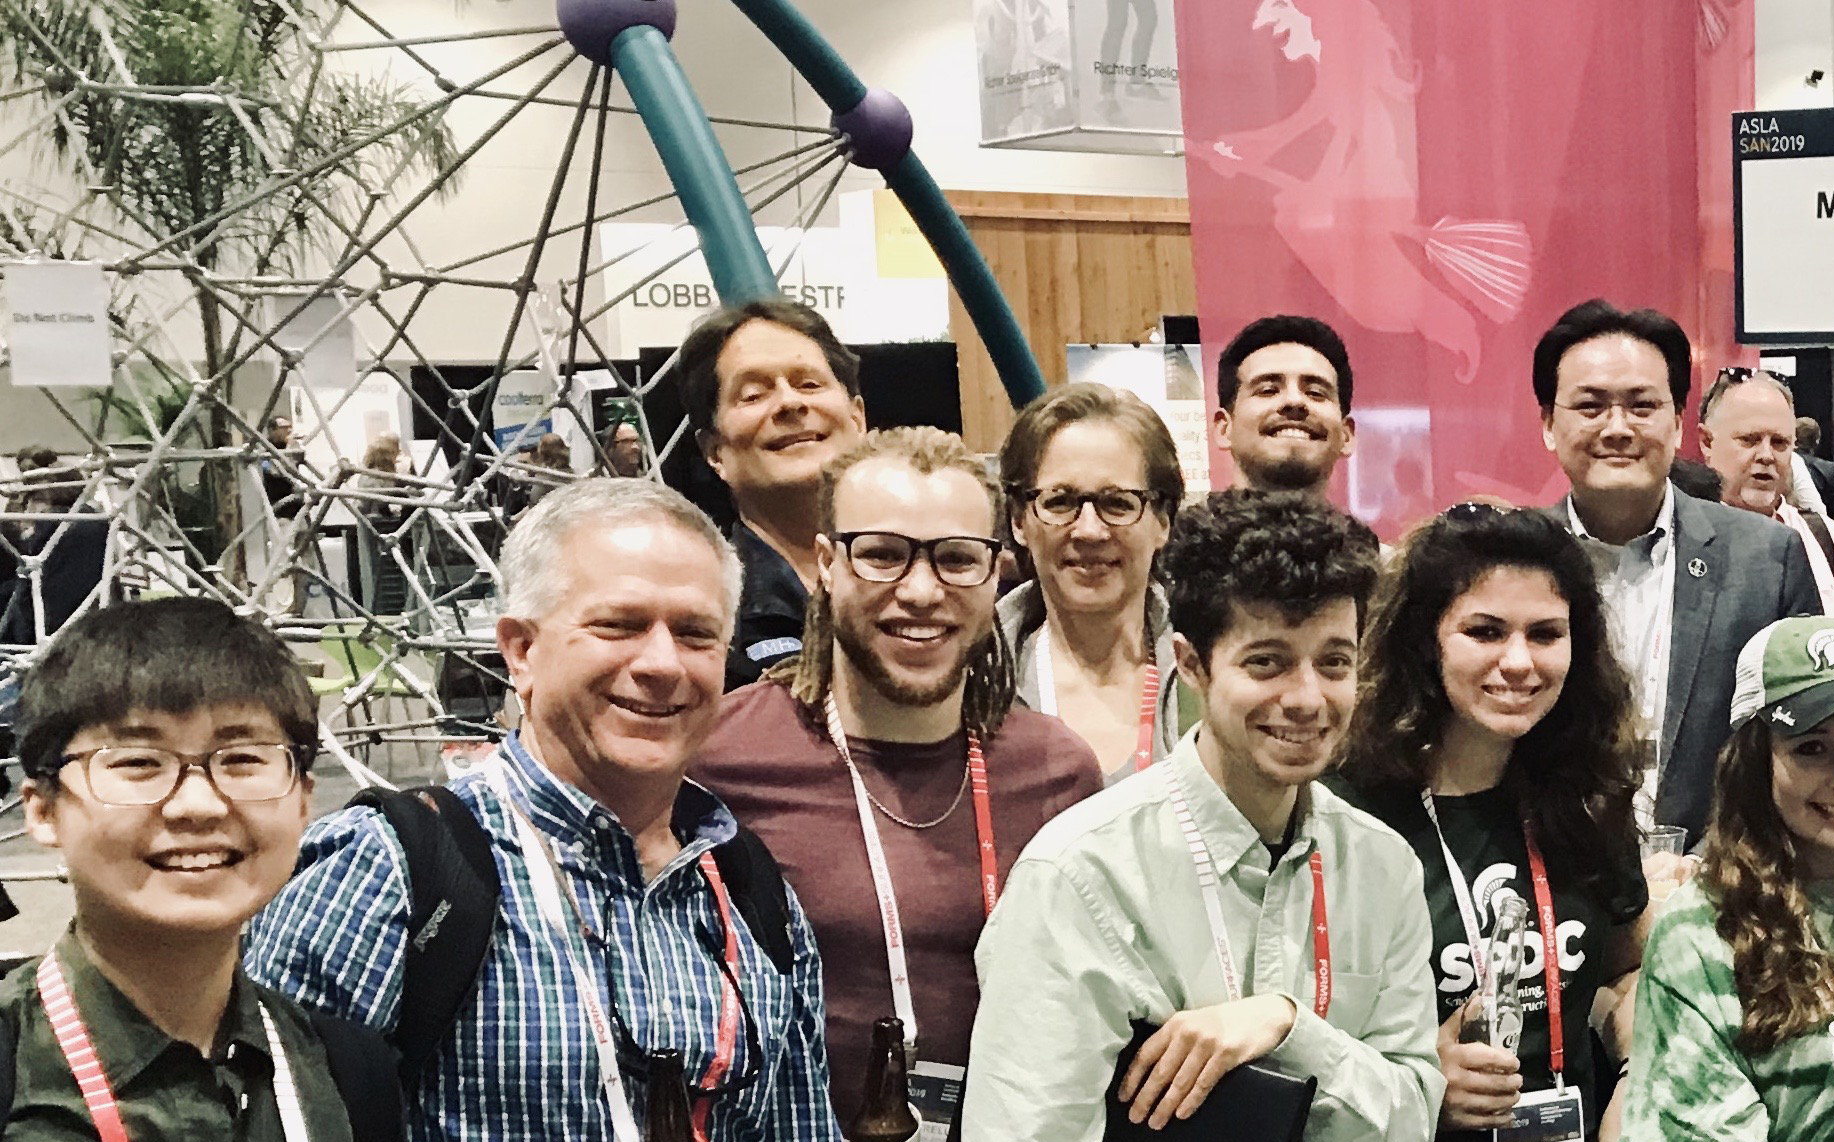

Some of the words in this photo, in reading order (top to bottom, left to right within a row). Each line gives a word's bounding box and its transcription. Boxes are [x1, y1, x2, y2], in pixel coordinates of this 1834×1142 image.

[1094, 61, 1137, 77] Richter
[1739, 117, 1779, 135] ASLA
[1740, 135, 1805, 153] SAN2019
[13, 312, 31, 323] Do
[33, 312, 57, 323] Not
[58, 312, 95, 323] Climb
